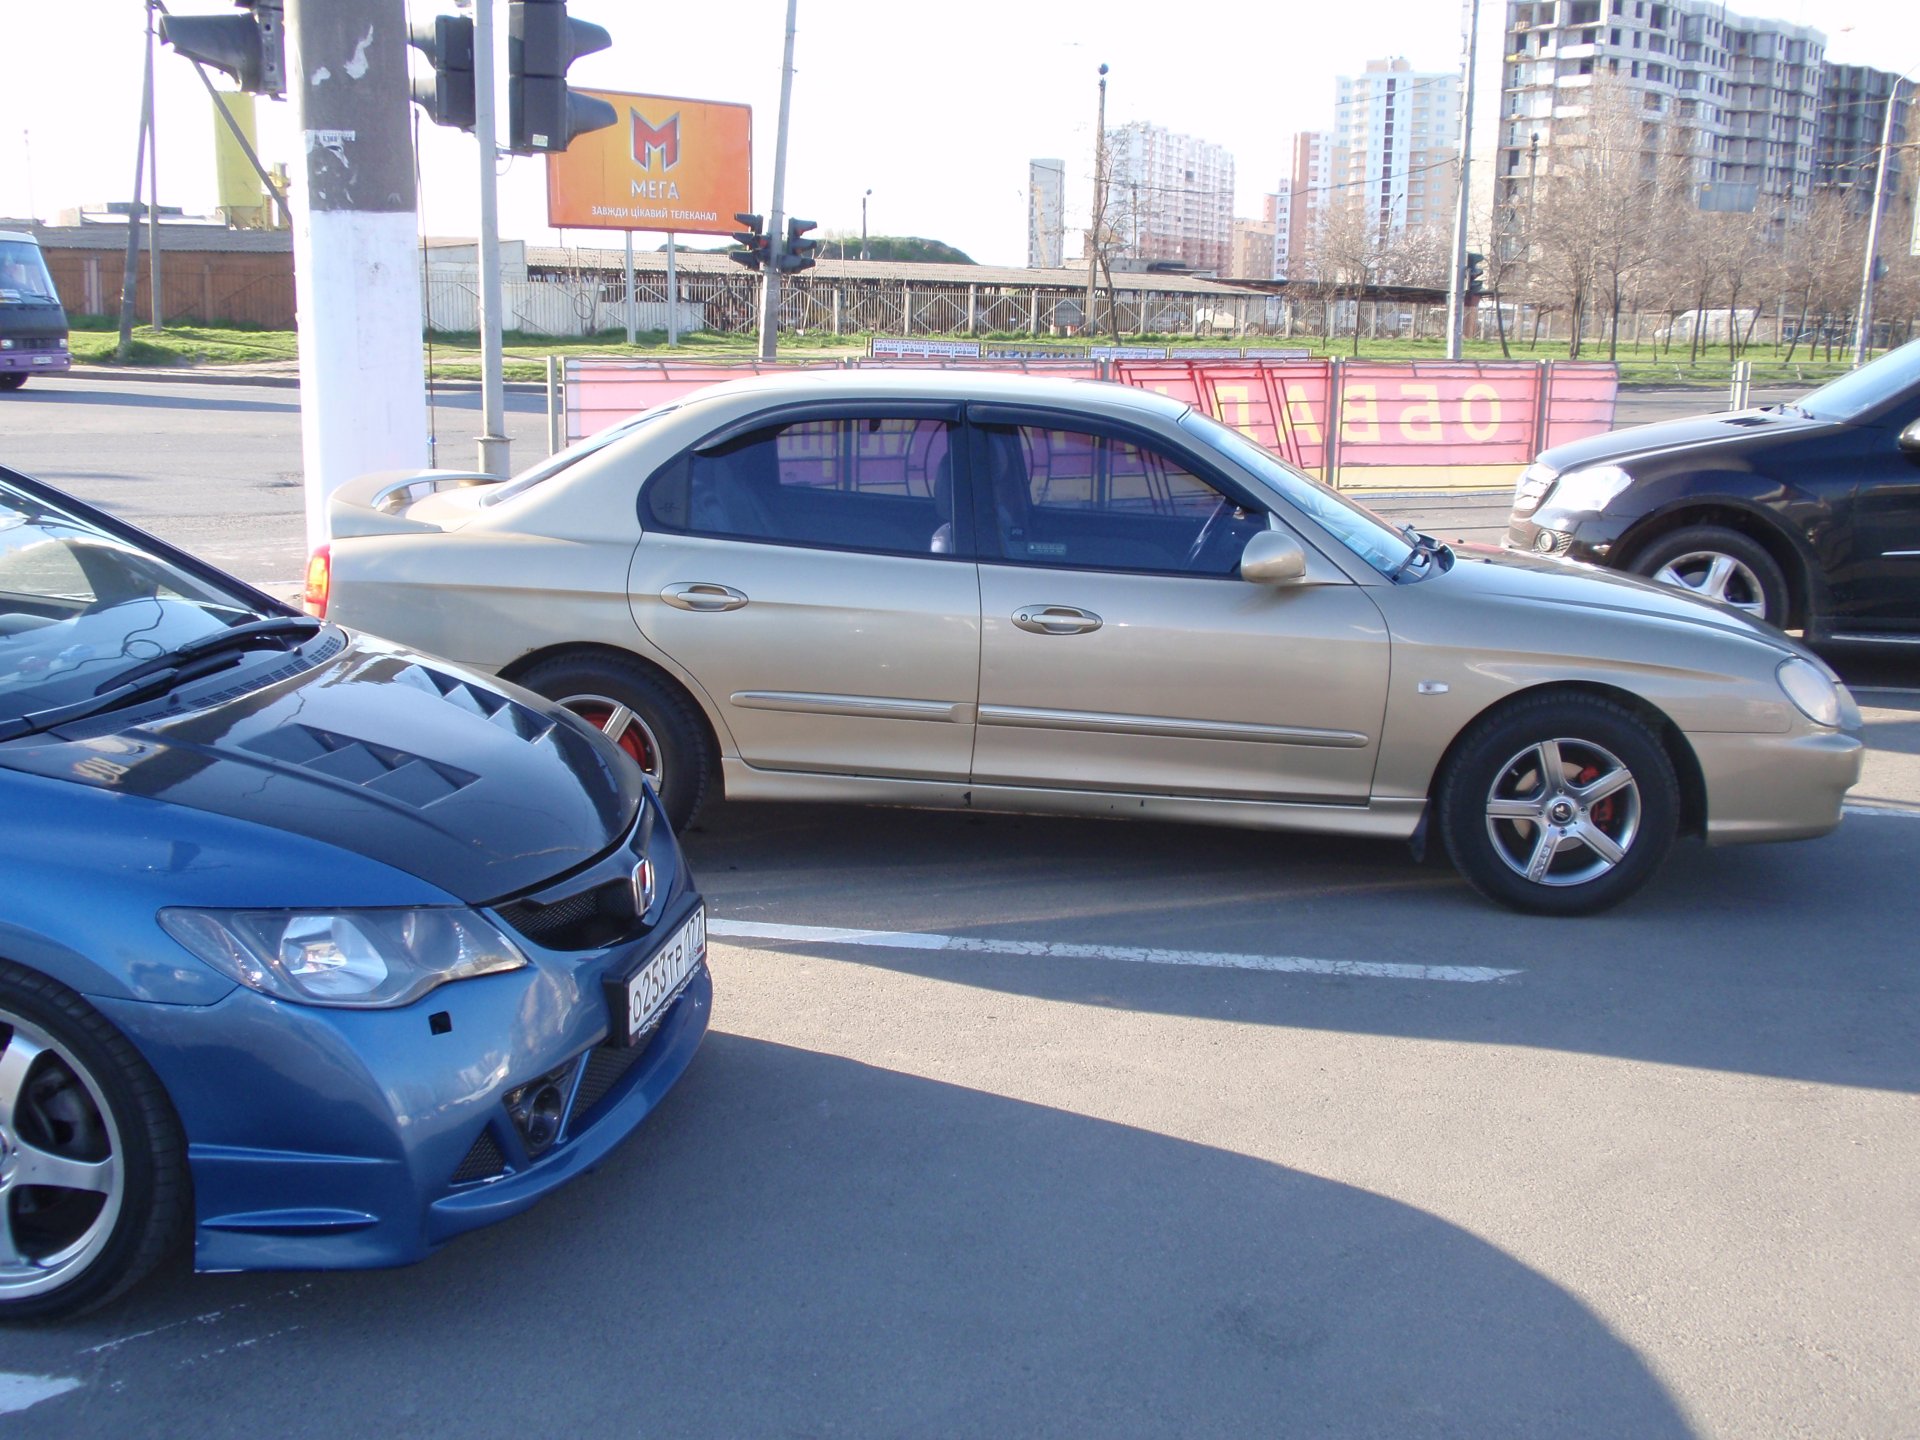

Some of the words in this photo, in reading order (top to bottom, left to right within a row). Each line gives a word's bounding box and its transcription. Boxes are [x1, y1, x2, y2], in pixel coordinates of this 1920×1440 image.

[631, 179, 679, 199] МЕГА
[592, 206, 628, 217] ЗАВЖДИ
[671, 210, 717, 221] ТЕЛЕКАНАЛ
